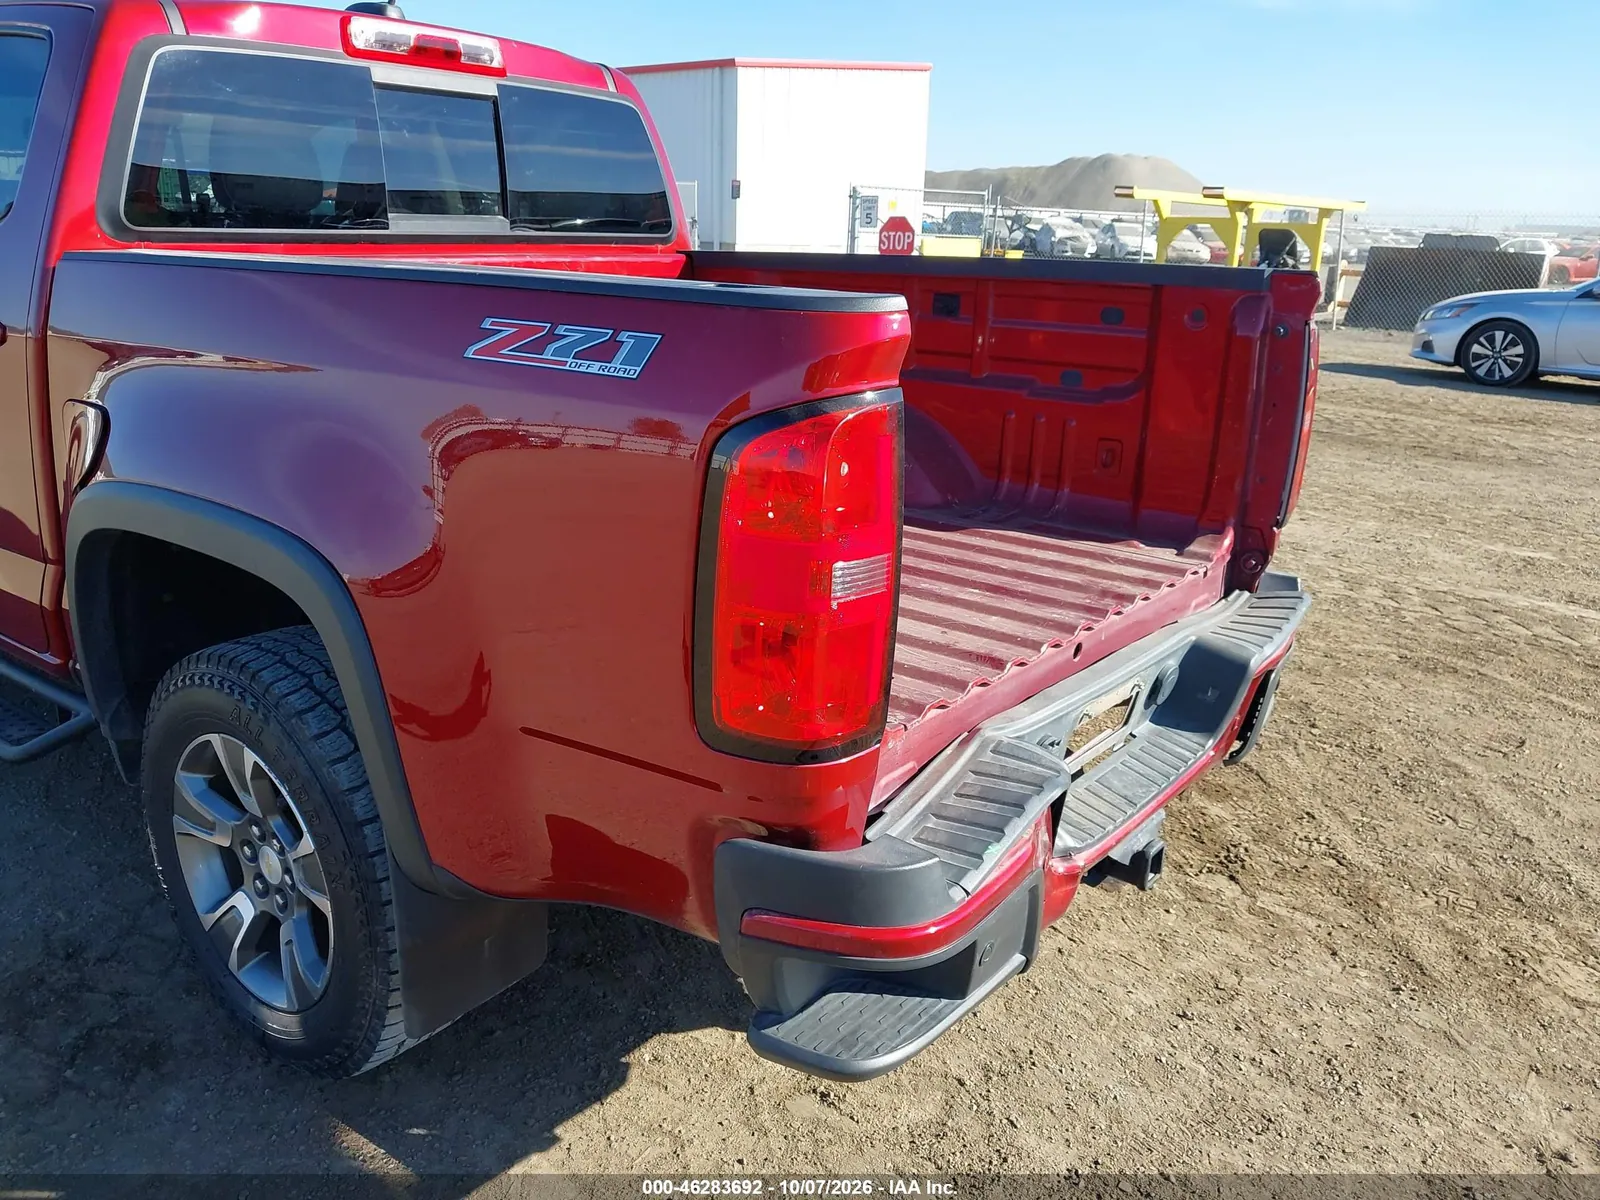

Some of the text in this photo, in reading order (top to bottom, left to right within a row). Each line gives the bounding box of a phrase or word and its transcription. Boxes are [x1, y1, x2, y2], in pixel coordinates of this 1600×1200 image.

[865, 213, 873, 224] 5
[880, 231, 913, 250] STOP
[463, 316, 664, 371] Z71
[568, 361, 638, 377] OFF ROAD
[229, 704, 344, 889] ALL TERRAIN
